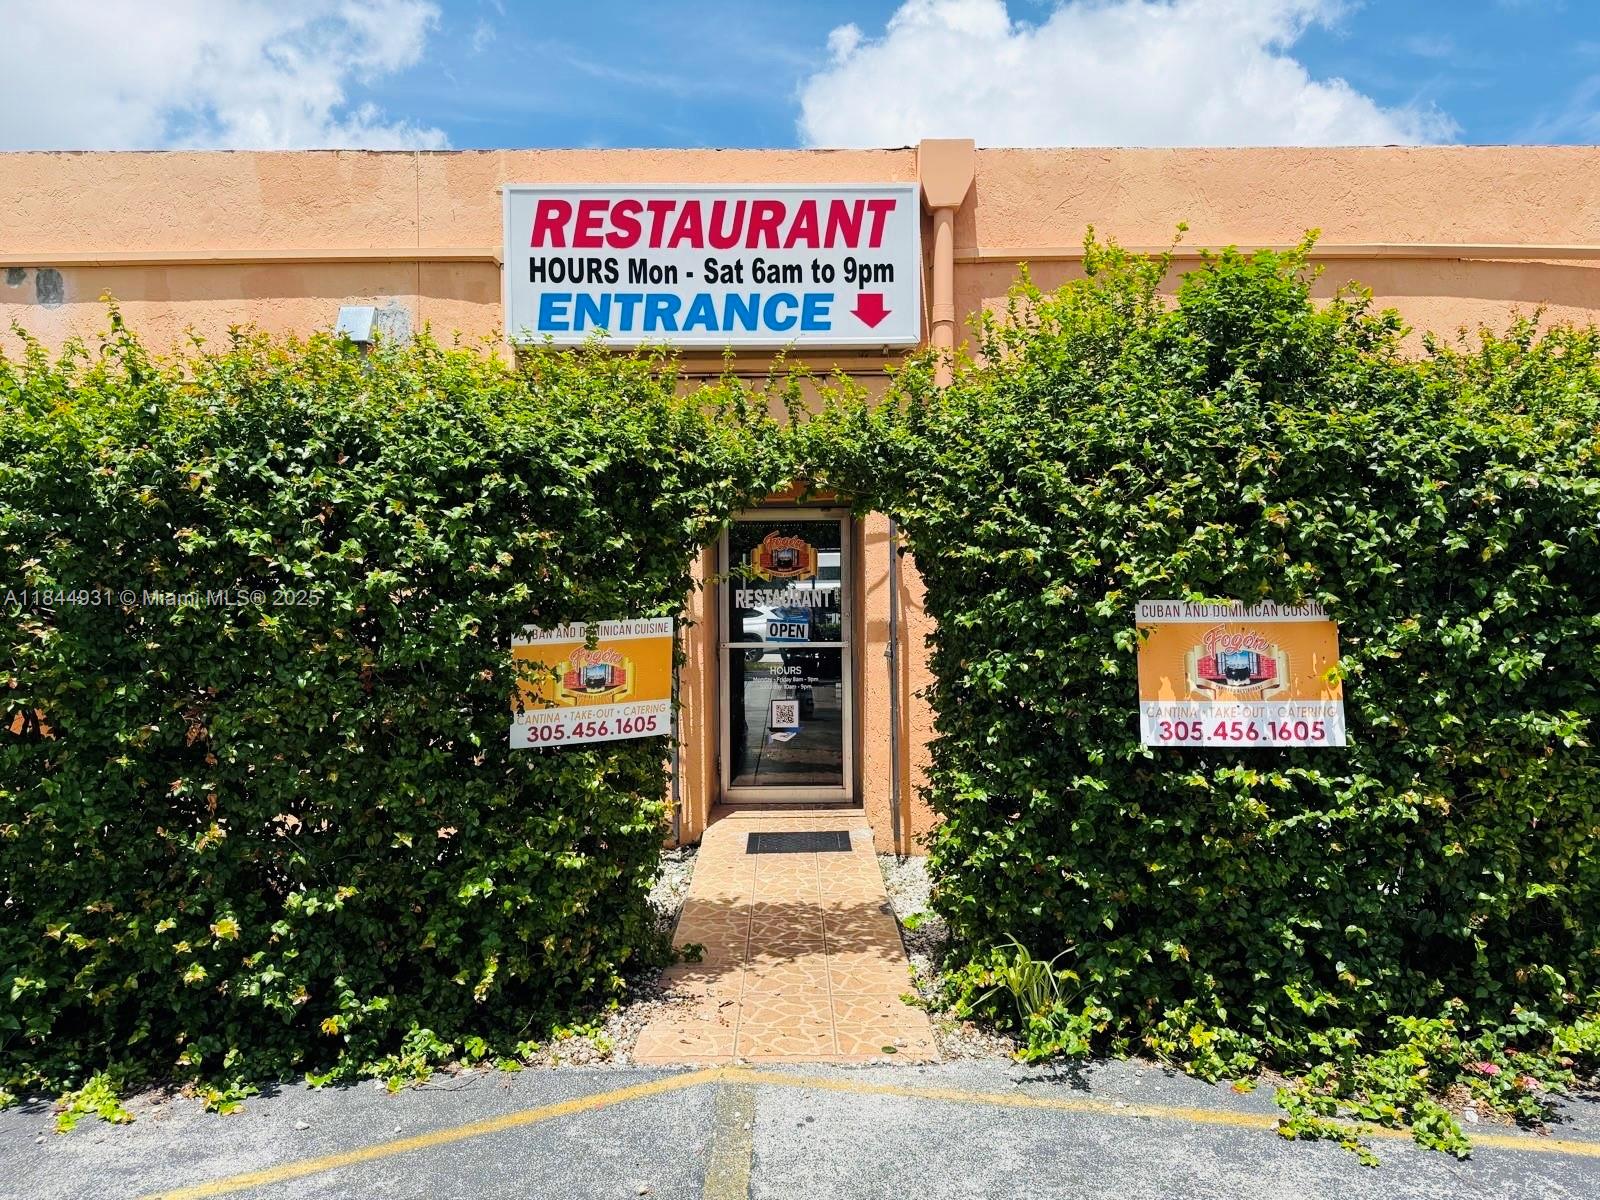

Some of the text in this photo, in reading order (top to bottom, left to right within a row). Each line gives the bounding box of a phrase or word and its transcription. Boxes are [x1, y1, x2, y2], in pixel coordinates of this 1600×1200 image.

[530, 199, 897, 249] RESTAURANT
[529, 257, 619, 284] HOURS
[628, 258, 678, 285] Mon
[703, 258, 743, 285] Sat
[752, 257, 803, 285] 6am
[812, 259, 835, 283] to
[843, 256, 894, 290] 9pm
[537, 292, 835, 332] ENTRANCE
[735, 588, 832, 609] RESTAURANT
[1141, 604, 1181, 618] CUBAN
[1185, 604, 1209, 618] AND
[1213, 604, 1279, 618] DOMINICAN
[556, 626, 576, 639] AND
[579, 623, 632, 638] DINICAN
[634, 622, 669, 635] CUISINE
[769, 623, 805, 639] OPEN
[1203, 623, 1269, 659] Fogón
[769, 666, 802, 675] HOURS
[516, 703, 666, 726] CANTINA TAKE-OUT CATERING
[1146, 706, 1337, 719] CANTINA TAKE-OUT CATERING
[527, 715, 657, 742] 305.456.1605
[1159, 721, 1326, 741] 305.456.1605
